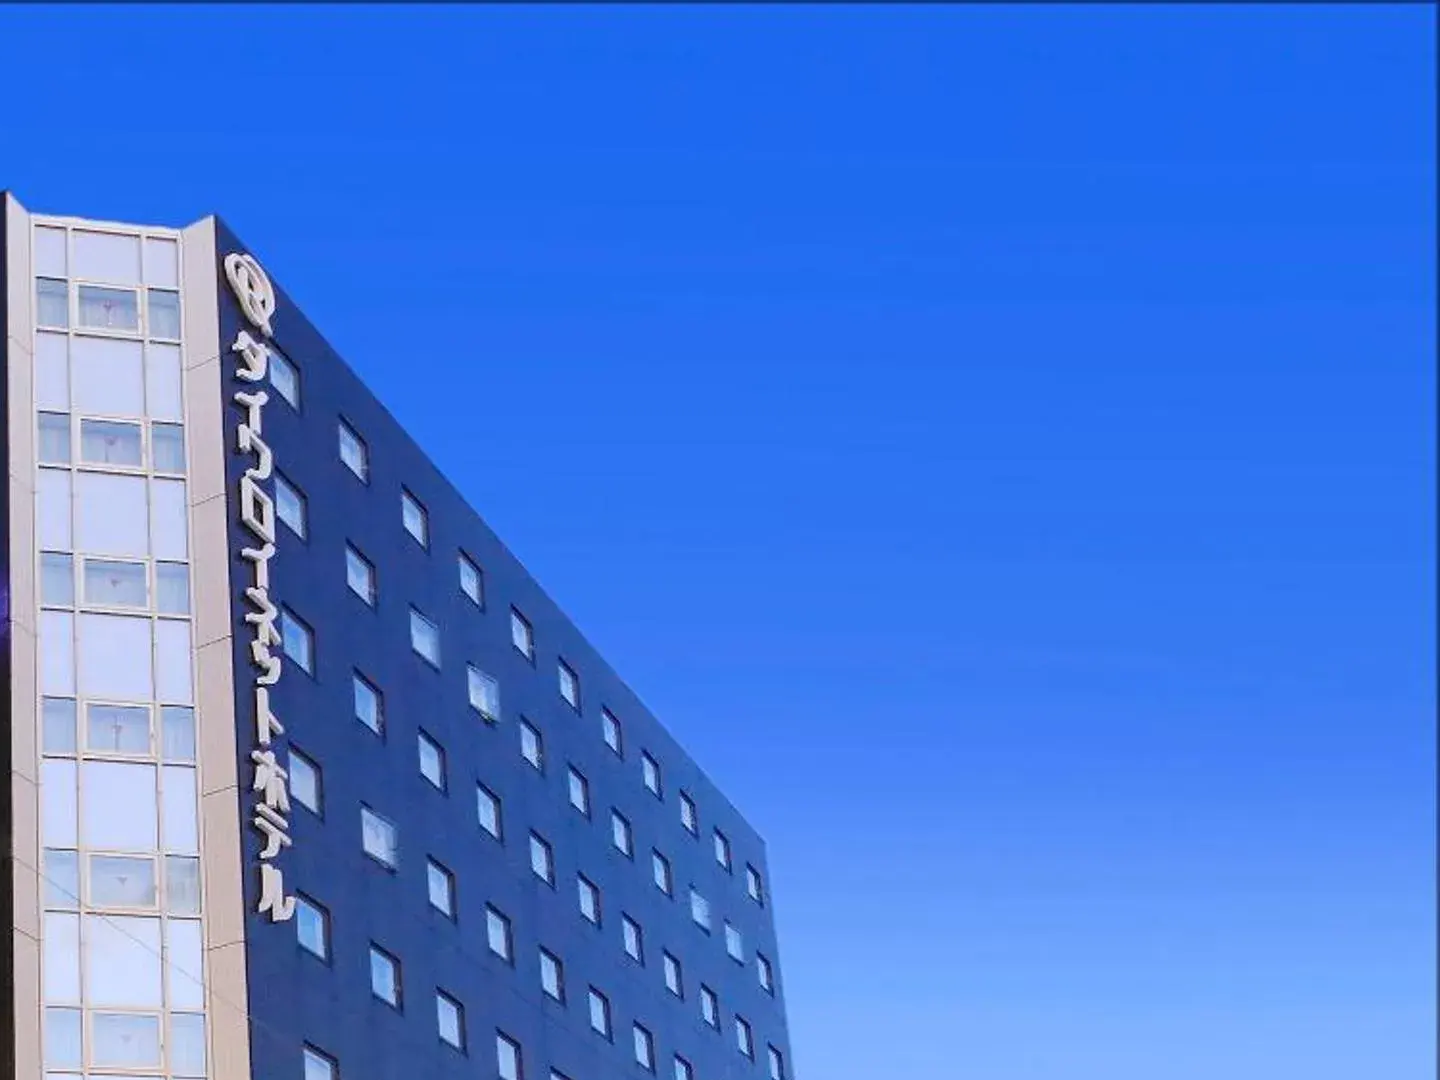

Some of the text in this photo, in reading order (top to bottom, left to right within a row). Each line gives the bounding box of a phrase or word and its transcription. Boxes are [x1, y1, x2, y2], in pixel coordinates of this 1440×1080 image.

[231, 331, 296, 922] ダイワロイネットホテル
